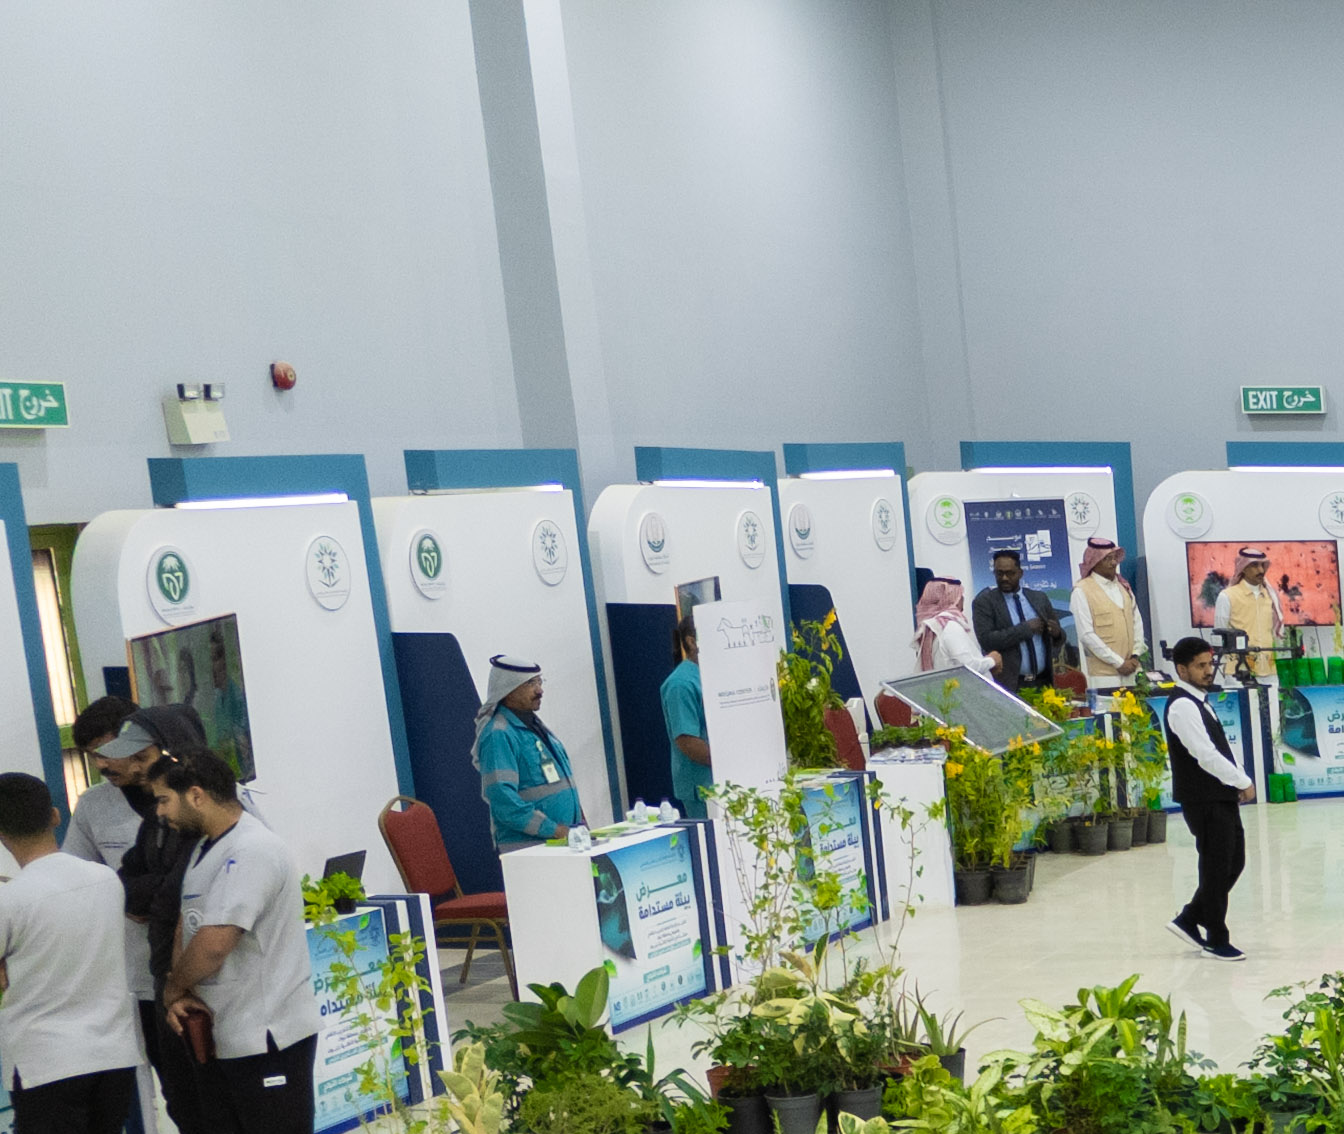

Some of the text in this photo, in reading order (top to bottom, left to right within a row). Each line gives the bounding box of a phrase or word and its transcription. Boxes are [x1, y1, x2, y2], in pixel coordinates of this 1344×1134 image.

[18, 389, 59, 420] خروج
[1247, 390, 1278, 410] EXIT
[1282, 390, 1316, 409] خروج
[638, 900, 674, 920] مستدامة
